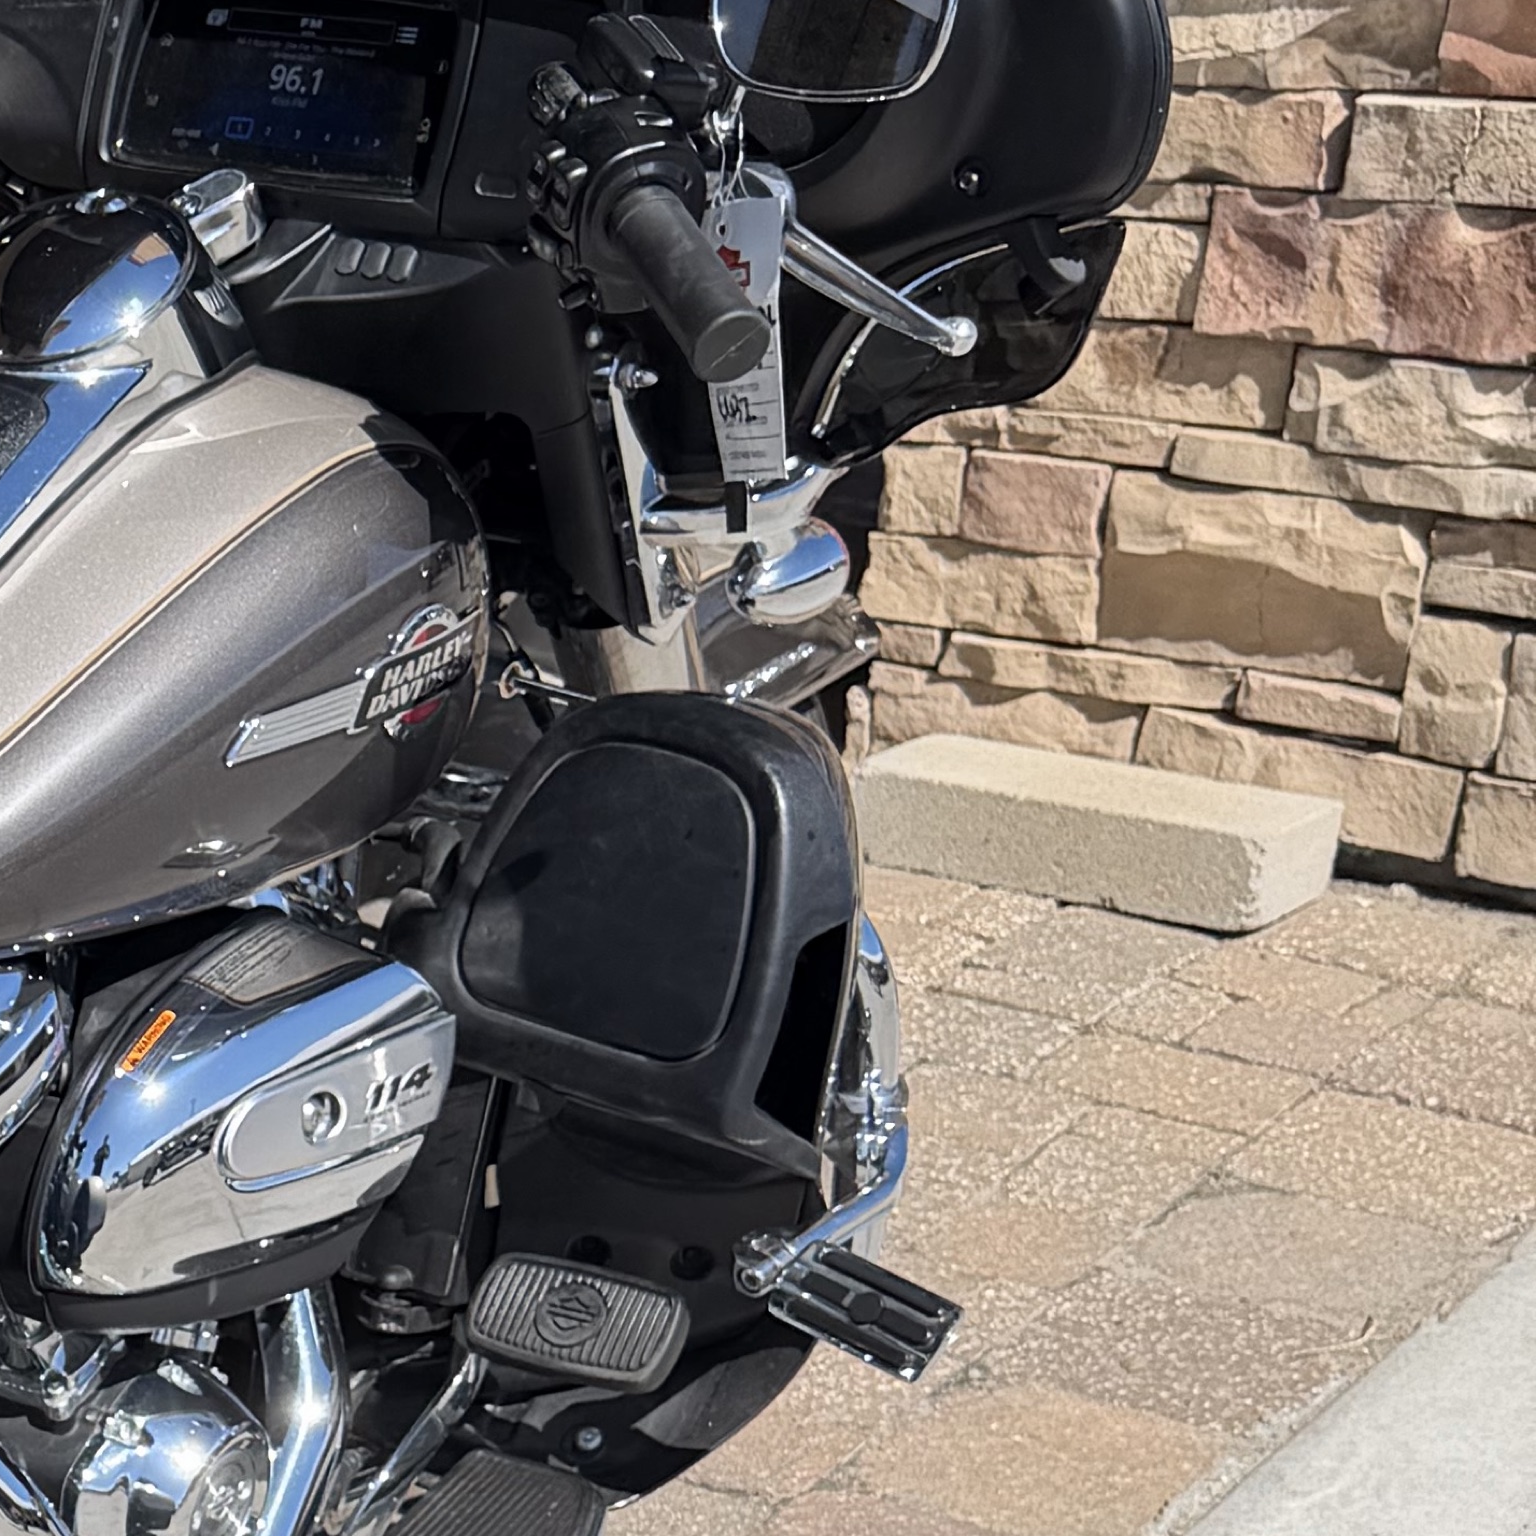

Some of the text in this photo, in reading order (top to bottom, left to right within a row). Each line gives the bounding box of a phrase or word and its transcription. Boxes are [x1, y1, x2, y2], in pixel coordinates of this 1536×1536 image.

[299, 17, 324, 30] FM
[269, 63, 324, 96] 96.1
[368, 1061, 433, 1111] 114
